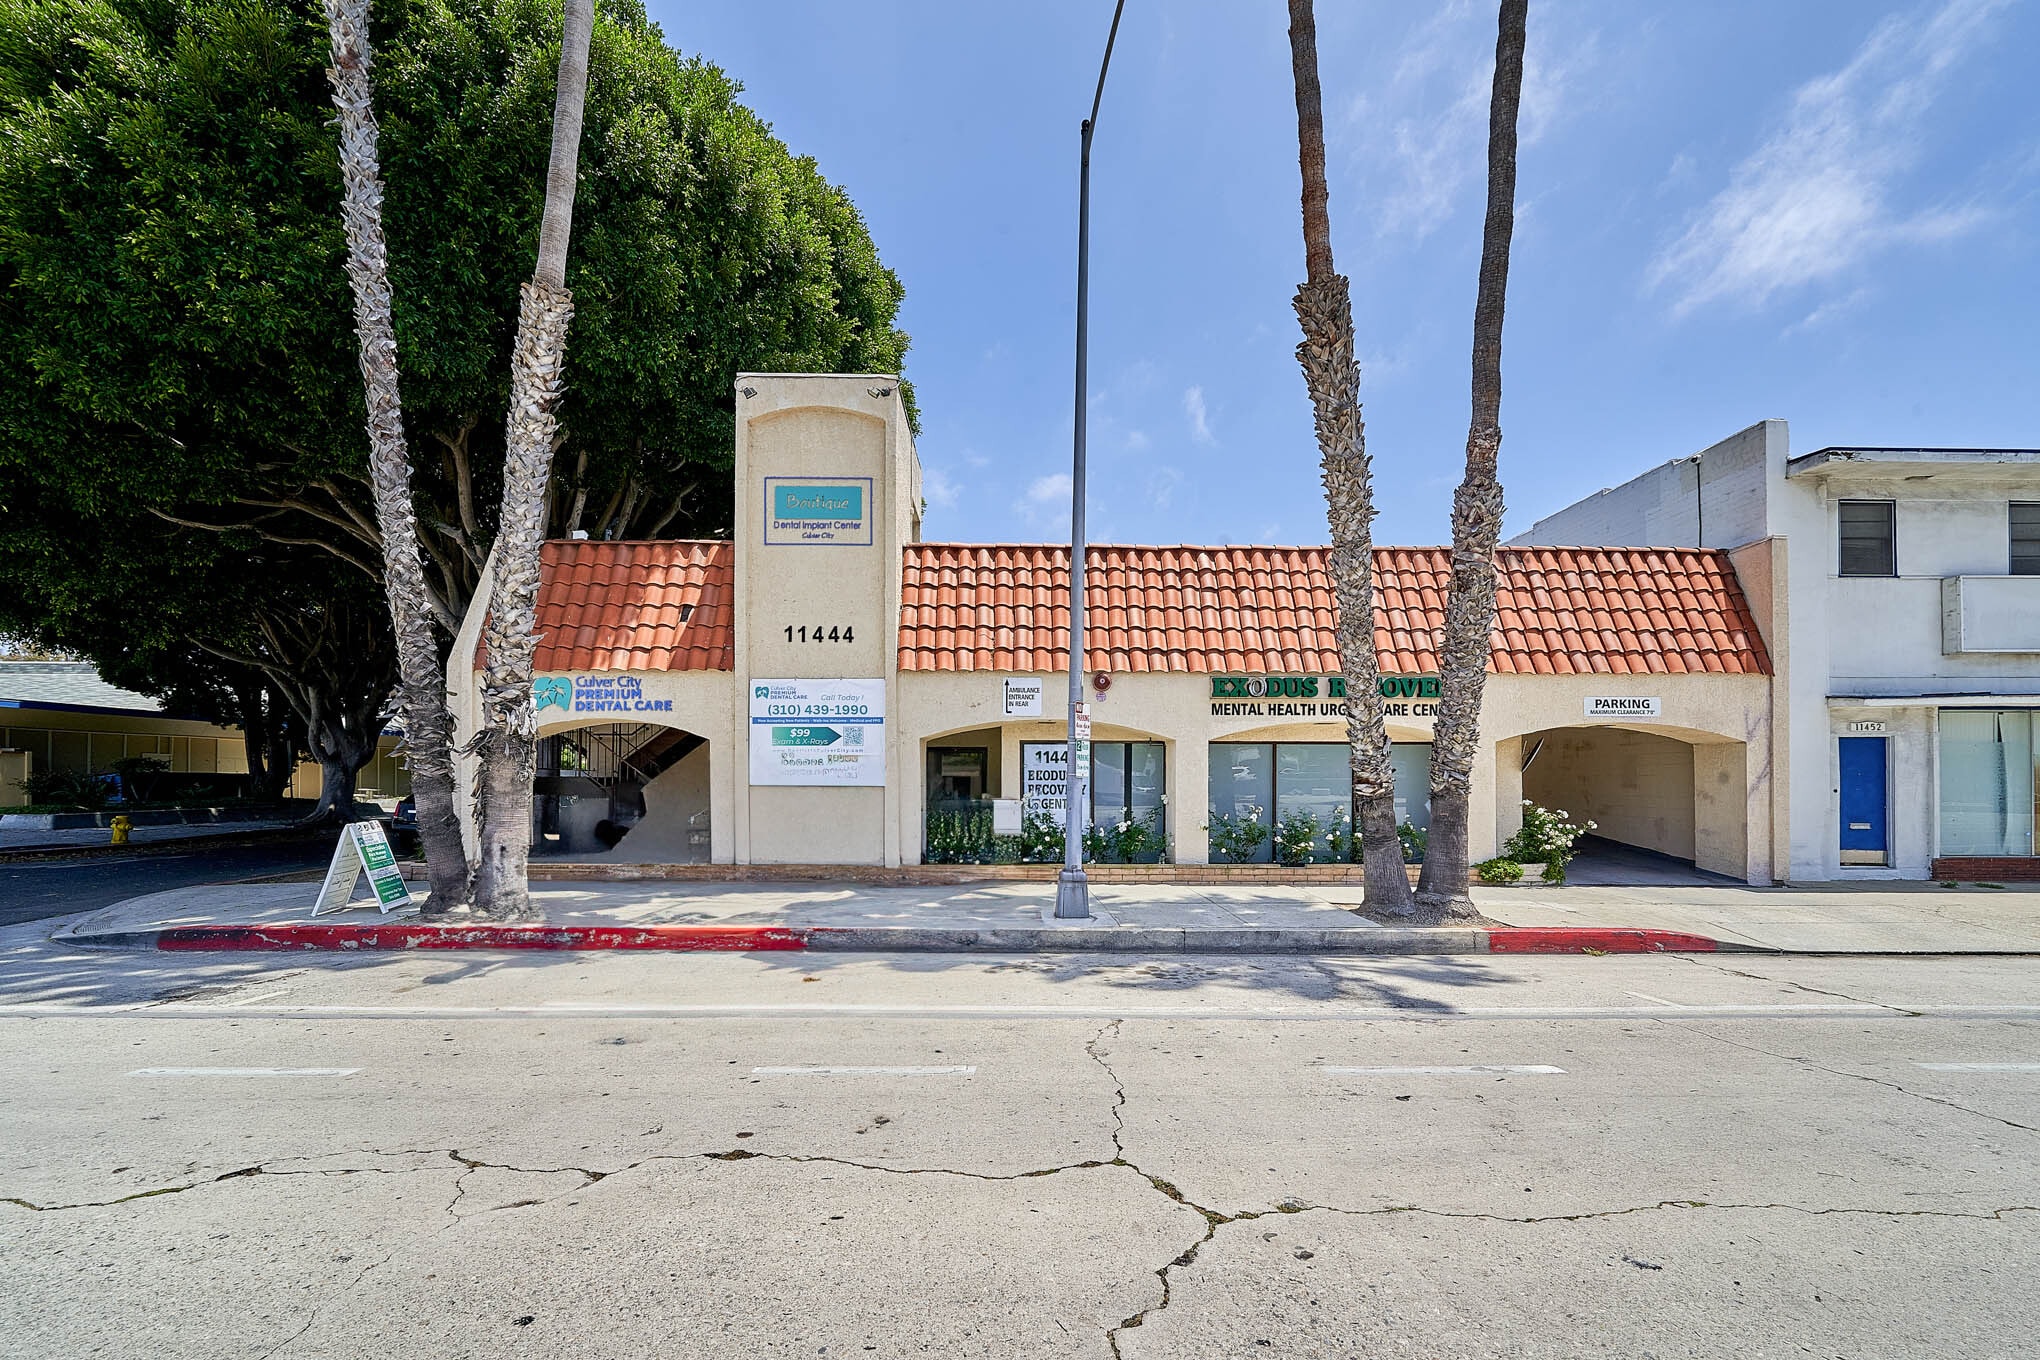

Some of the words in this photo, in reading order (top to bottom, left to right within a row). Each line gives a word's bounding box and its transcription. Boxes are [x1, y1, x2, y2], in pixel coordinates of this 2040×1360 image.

[786, 494, 848, 510] Boutique
[773, 521, 800, 529] Dental
[802, 521, 832, 531] Implant
[834, 521, 862, 529] Center
[784, 625, 854, 643] 11444
[575, 676, 615, 688] Culver
[617, 676, 642, 689] City
[1212, 677, 1318, 698] EXODUS
[1328, 677, 1441, 698] ROVE
[575, 689, 642, 699] PREMIUM
[575, 700, 632, 711] DENTAL
[634, 700, 673, 711] CARE
[1211, 703, 1264, 716] MENTAL
[1268, 703, 1316, 716] HEALTH
[1320, 703, 1347, 716] URG
[1383, 703, 1408, 716] ARE
[1413, 703, 1440, 716] CEN
[1594, 699, 1650, 709] PARKING
[768, 704, 801, 716] (310)
[804, 705, 868, 715] 439-1990
[1855, 723, 1882, 731] 11452
[790, 728, 810, 738] $99
[802, 738, 829, 746] X-Rays
[1035, 751, 1068, 763] 1144
